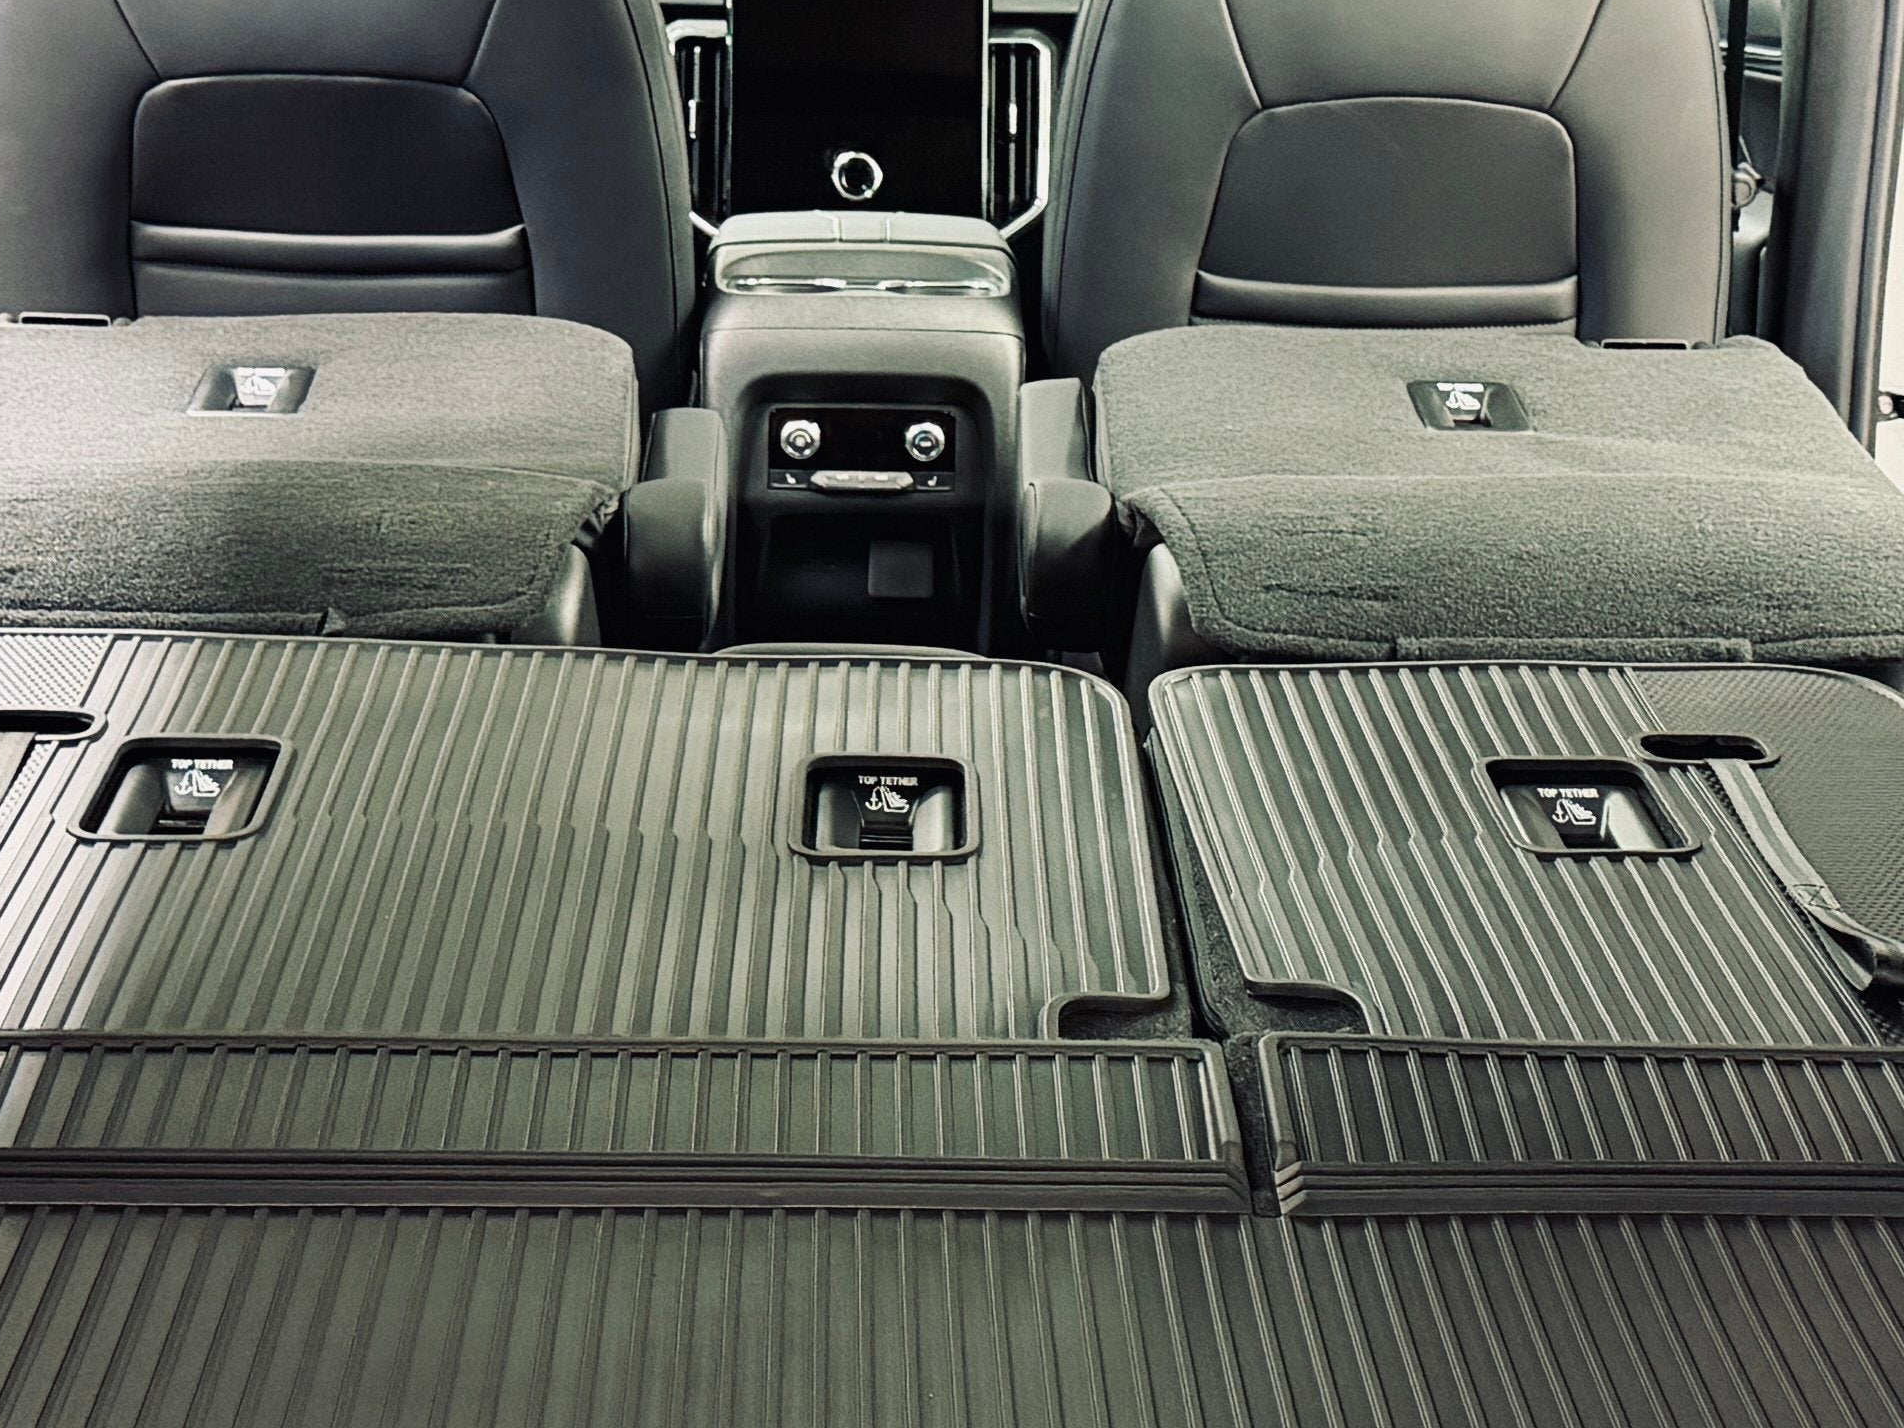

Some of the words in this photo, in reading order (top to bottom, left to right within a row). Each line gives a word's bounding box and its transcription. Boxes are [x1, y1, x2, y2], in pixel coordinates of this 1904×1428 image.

[858, 775, 878, 785] TOP
[879, 776, 919, 786] TETHER
[1536, 787, 1558, 798] TOP
